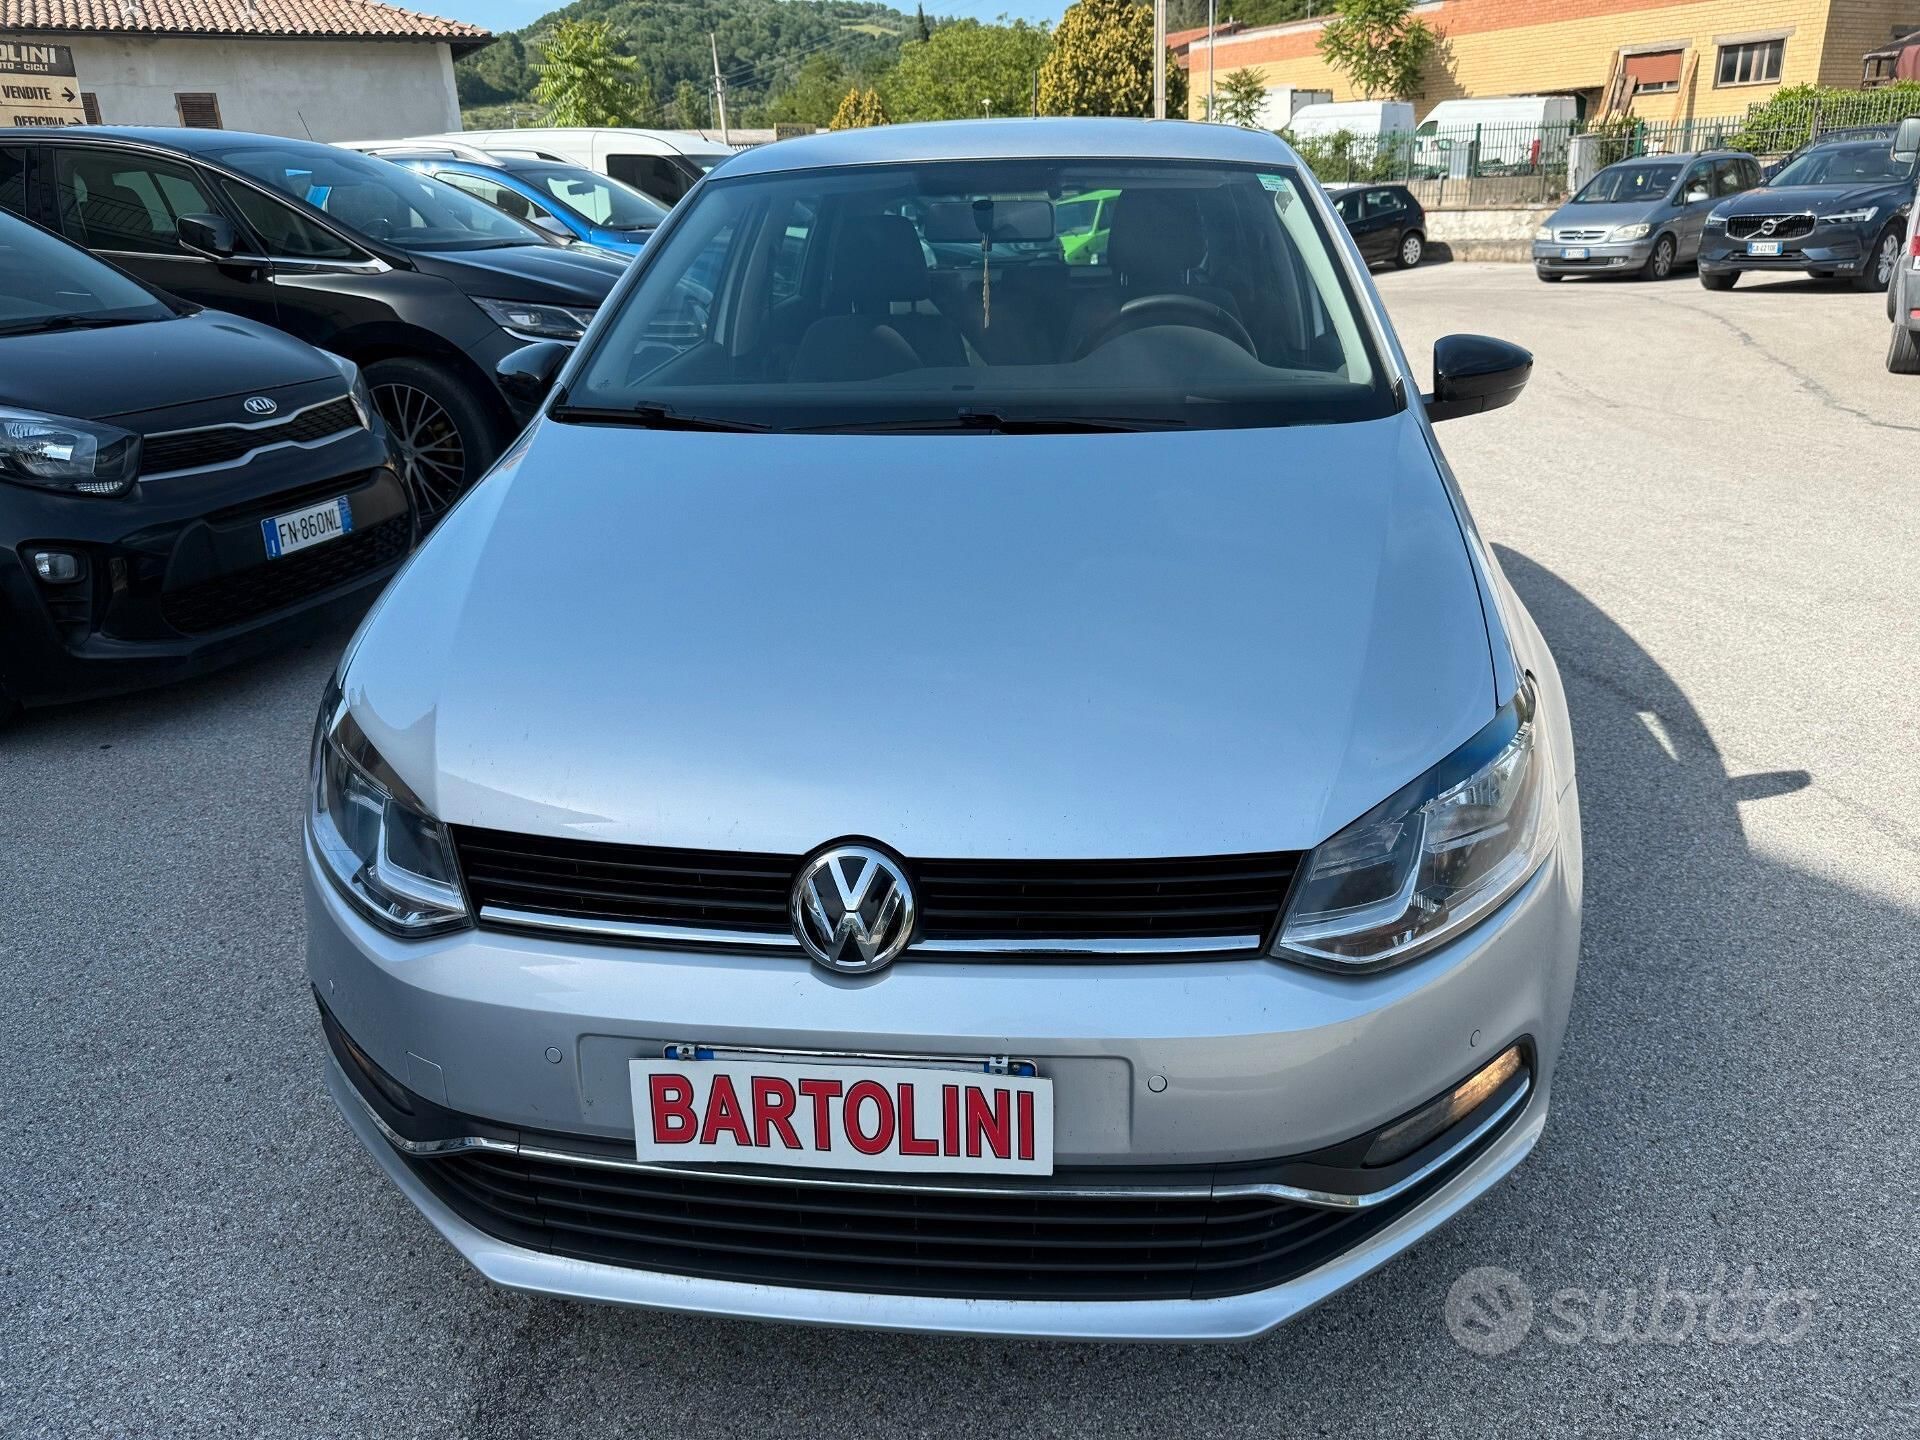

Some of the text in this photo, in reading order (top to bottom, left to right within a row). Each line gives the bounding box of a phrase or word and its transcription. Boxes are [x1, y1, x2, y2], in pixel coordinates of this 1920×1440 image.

[23, 63, 48, 72] CICLI
[1, 85, 52, 100] VENDITE
[13, 115, 65, 126] OFFICINA
[249, 398, 274, 412] KIA
[648, 1073, 1035, 1161] BARTOLINI
